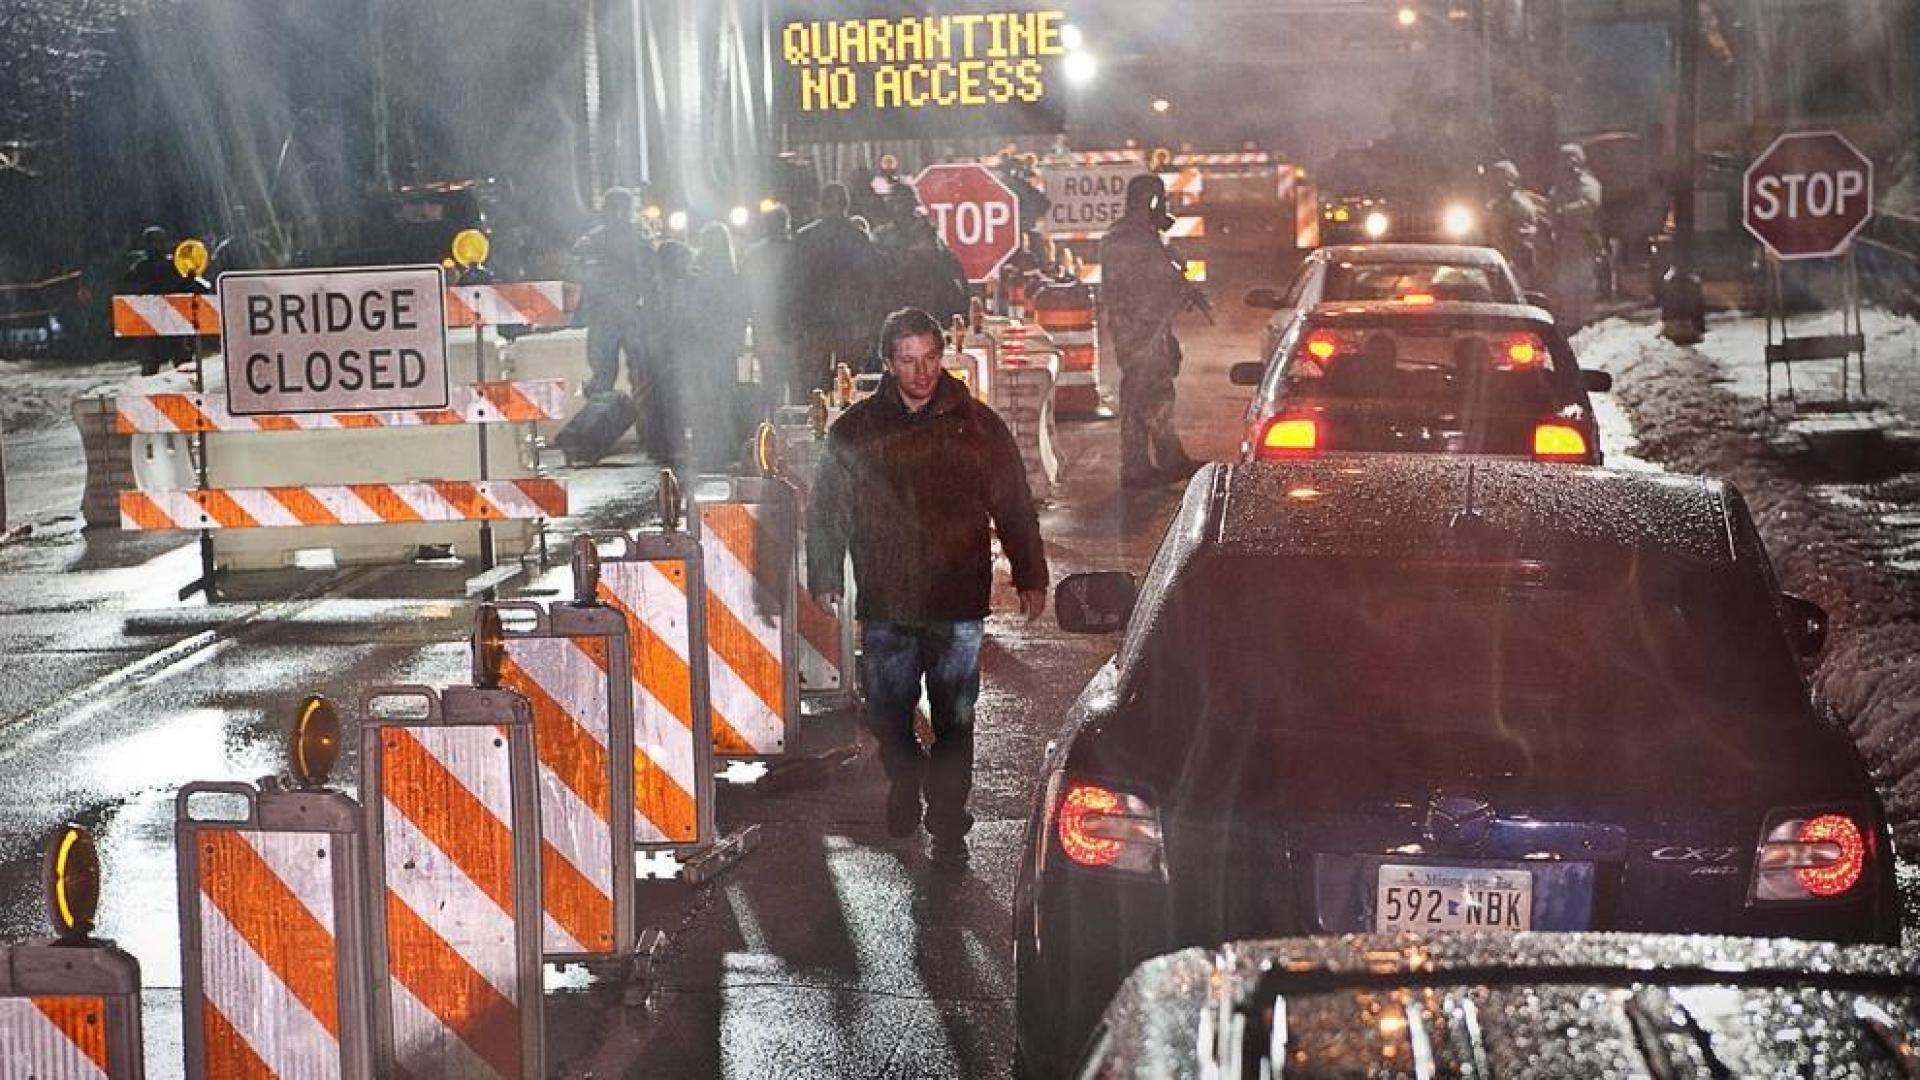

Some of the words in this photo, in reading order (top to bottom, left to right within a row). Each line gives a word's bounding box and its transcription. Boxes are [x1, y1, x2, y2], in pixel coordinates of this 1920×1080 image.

[783, 11, 1064, 65] QUARANTINE
[802, 67, 856, 110] NO
[875, 59, 1042, 108] ACCESS
[1064, 176, 1124, 196] ROAD
[1754, 170, 1863, 220] STOP
[921, 201, 1010, 246] TOP
[1053, 202, 1122, 223] CLOSE
[248, 289, 417, 336] BRIDGE
[246, 348, 426, 394] CLOSED
[1387, 888, 1442, 924] 592
[1465, 891, 1521, 927] NBK
